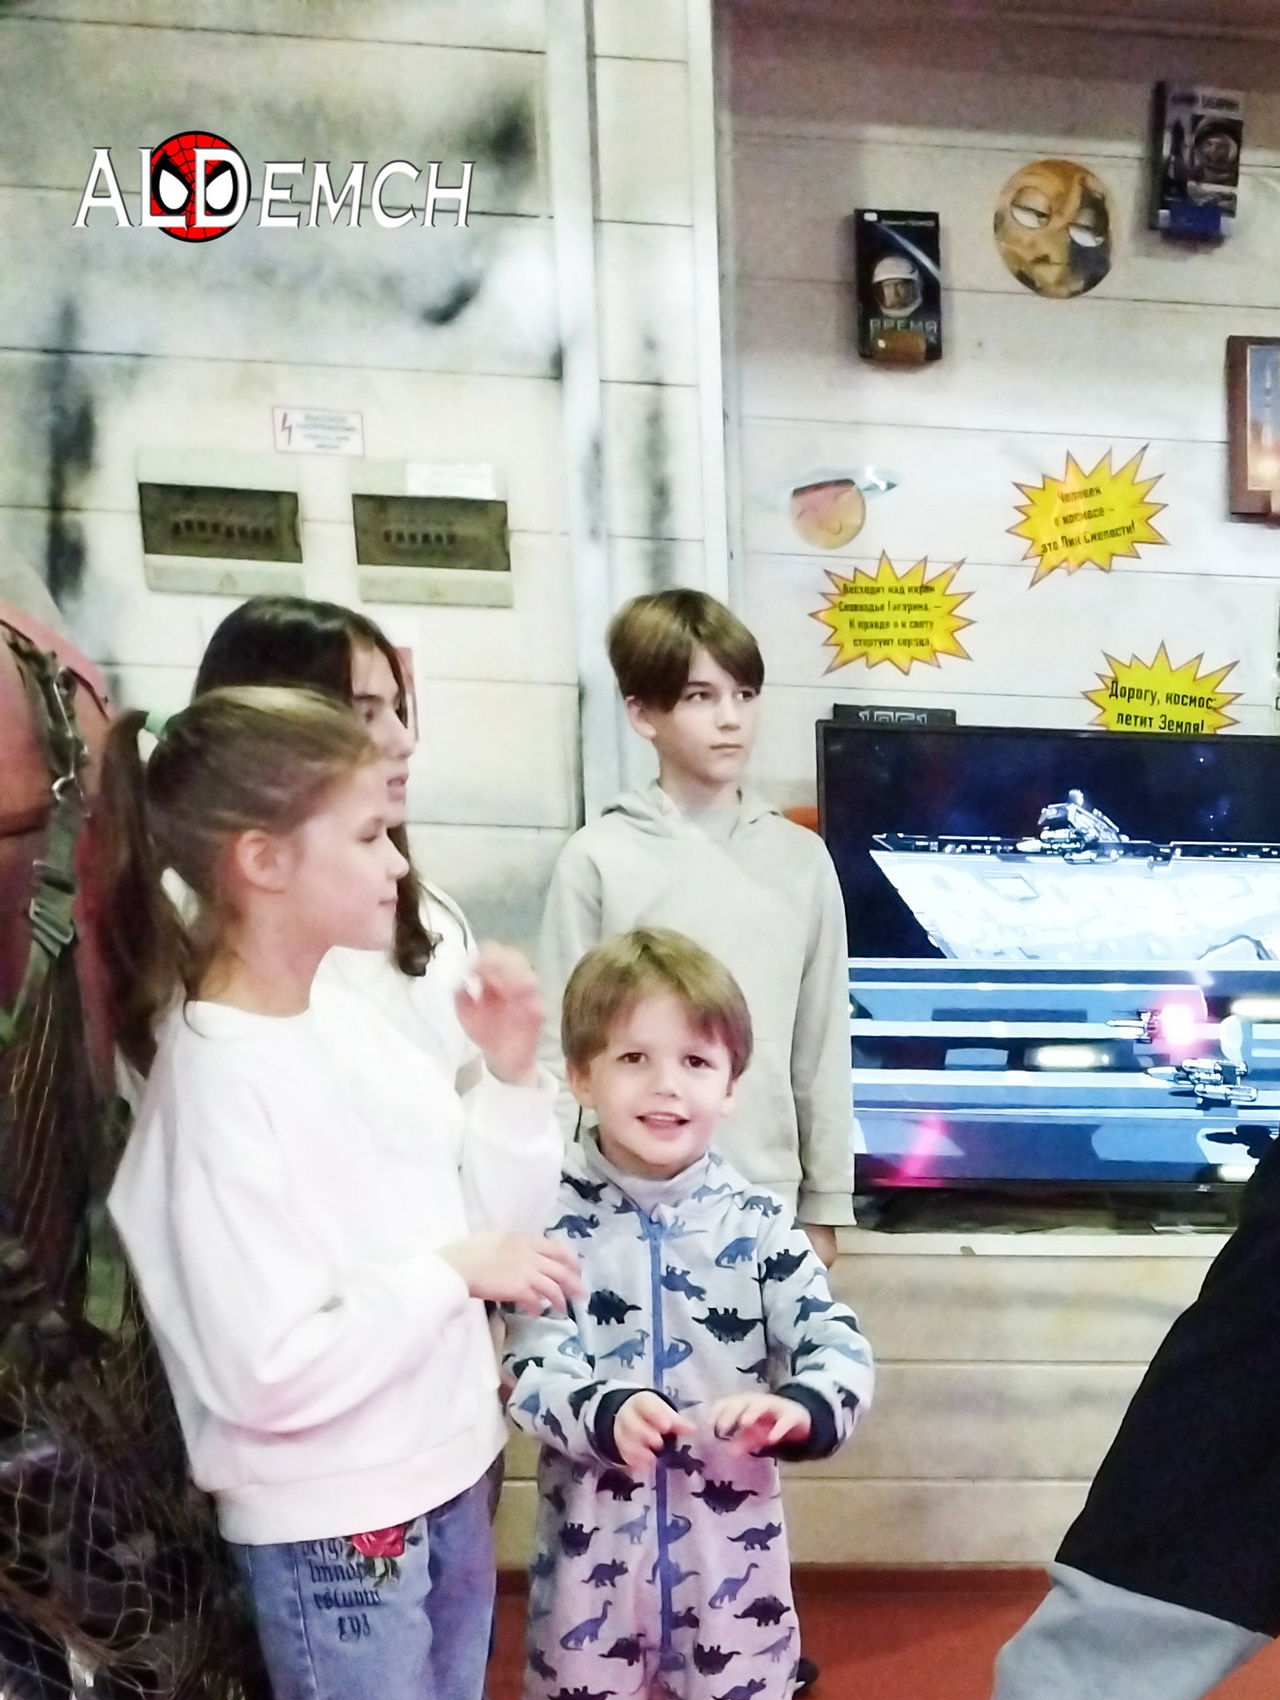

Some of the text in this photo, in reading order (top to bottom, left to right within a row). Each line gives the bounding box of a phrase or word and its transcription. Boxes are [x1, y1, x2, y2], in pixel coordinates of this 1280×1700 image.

[1058, 487, 1101, 503] Человек
[1063, 507, 1105, 525] космосе
[1041, 538, 1058, 554] это
[1084, 520, 1136, 544] Смелости!
[1108, 680, 1160, 706] Дорогу,
[1116, 712, 1205, 733] летит Земля!
